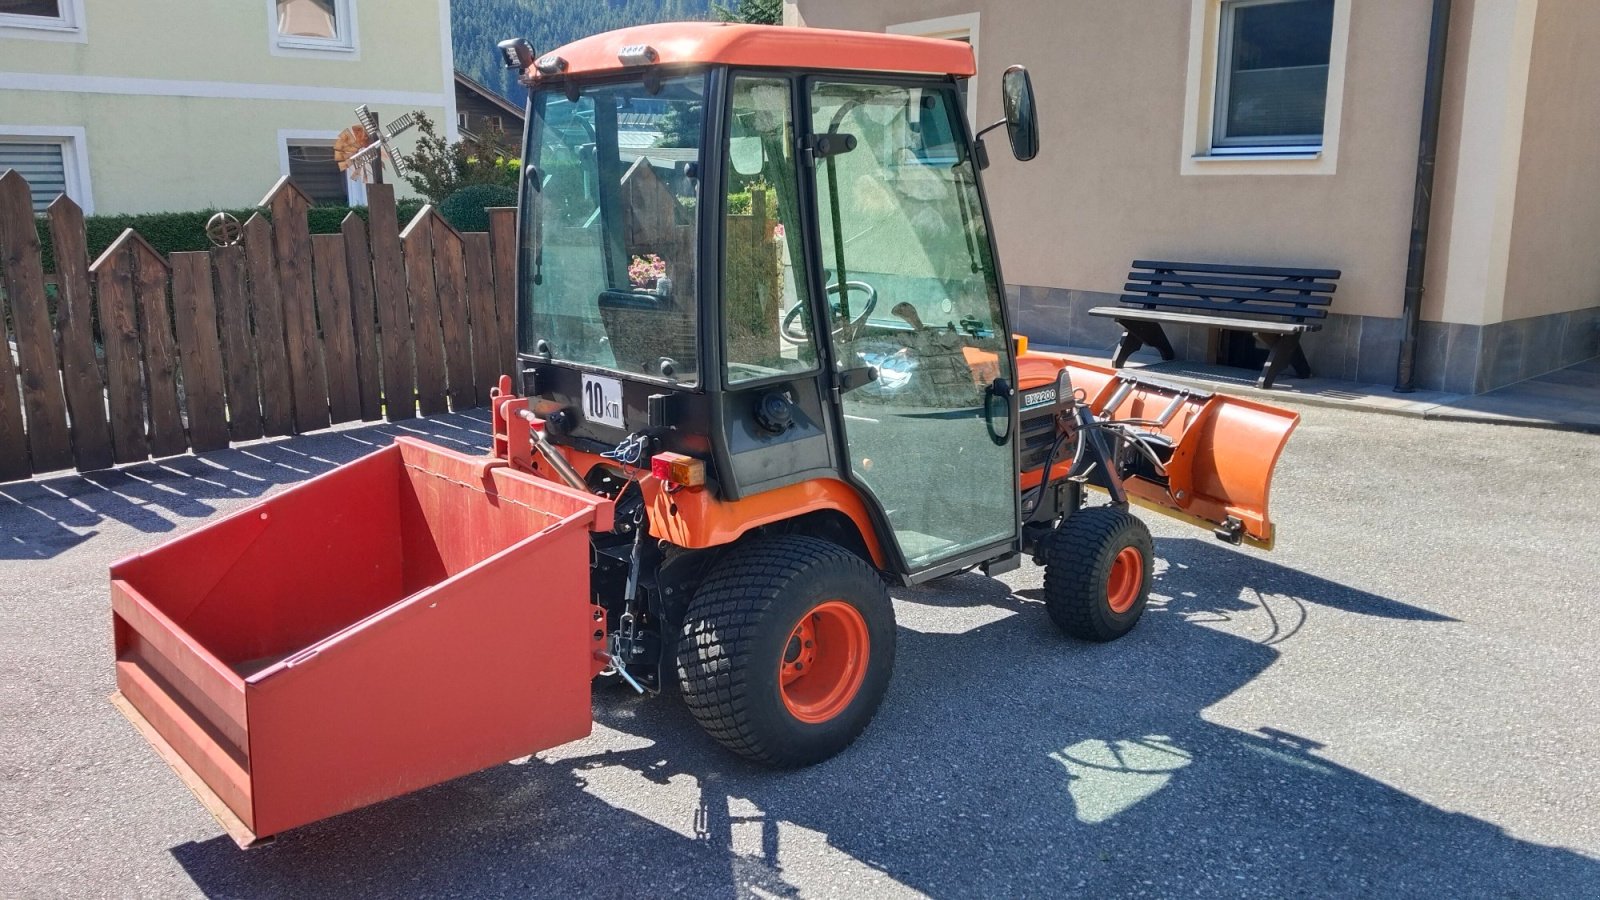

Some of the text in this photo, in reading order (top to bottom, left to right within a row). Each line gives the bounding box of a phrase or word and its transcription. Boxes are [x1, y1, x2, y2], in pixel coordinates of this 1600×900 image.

[585, 380, 619, 419] 10 km
[1025, 389, 1056, 405] BX2200
